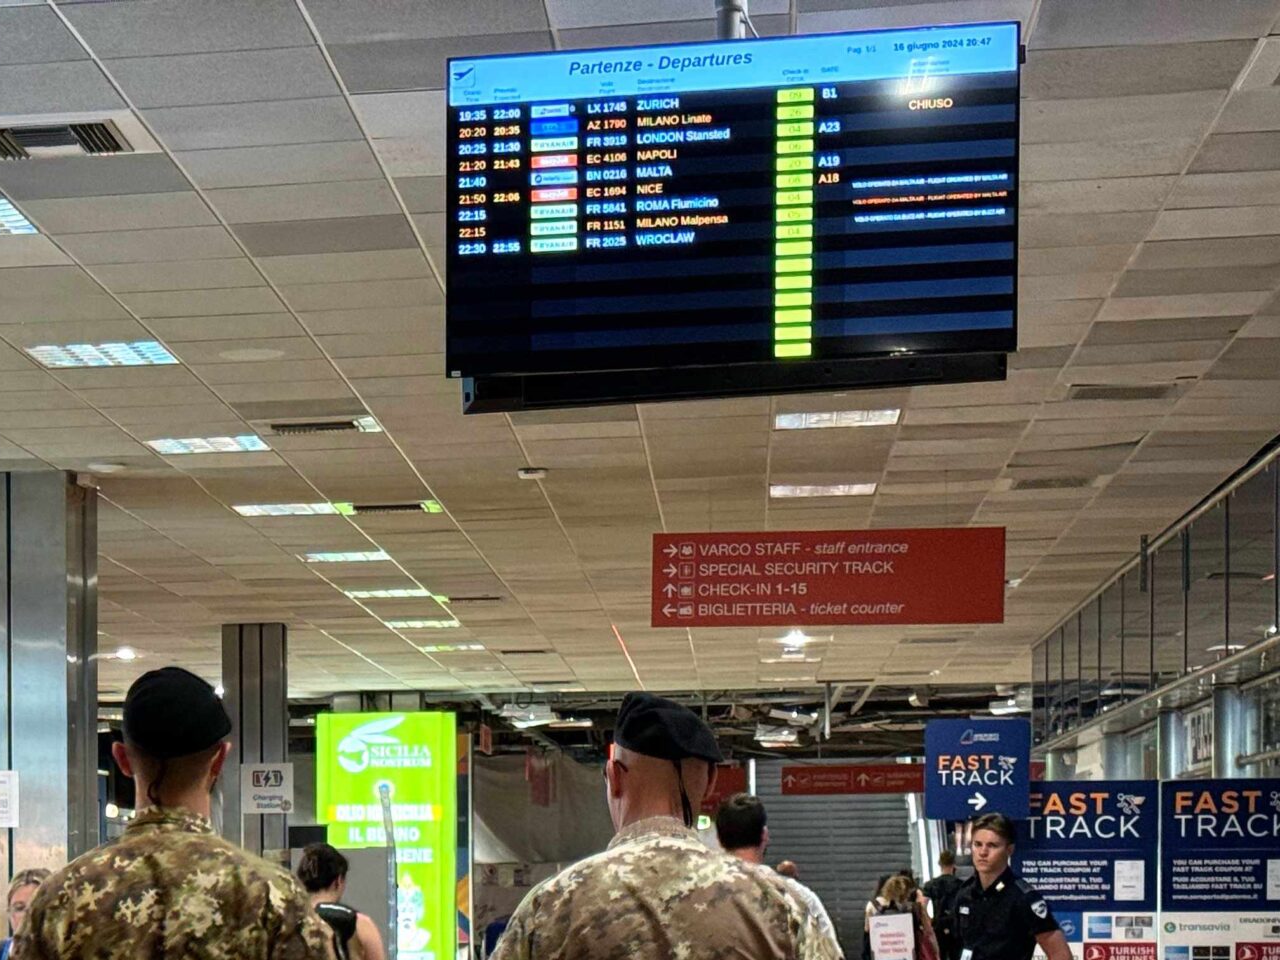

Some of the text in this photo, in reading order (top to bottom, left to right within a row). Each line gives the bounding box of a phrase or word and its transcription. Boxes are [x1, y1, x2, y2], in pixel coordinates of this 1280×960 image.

[894, 38, 991, 52] 16 giugno 2024 20:47
[569, 60, 643, 75] Partenze
[658, 52, 753, 72] Departures
[459, 110, 487, 121] 19:35
[493, 108, 521, 119] 22:00
[587, 103, 601, 113] LX
[603, 102, 627, 112] 1745
[636, 98, 679, 111] ZURICH
[822, 88, 837, 99] B1
[459, 127, 486, 138] 20:20
[493, 125, 520, 136] 20:35
[587, 121, 601, 131] AZ
[637, 116, 680, 127] MILANO
[682, 114, 712, 125] Linate
[908, 98, 953, 110] CHIUSO
[459, 143, 487, 155] 20:25
[493, 142, 521, 153] 21:30
[587, 137, 601, 147] FR
[637, 131, 684, 144] LONDON
[686, 128, 730, 141] Stansted
[818, 121, 840, 133] A23
[459, 161, 486, 171] 21:20
[493, 159, 520, 169] 21:43
[586, 155, 601, 164] EC
[603, 153, 627, 163] 4106
[637, 149, 677, 161] NAPOLI
[459, 177, 486, 188] 21:40
[586, 171, 601, 181] BN
[603, 169, 627, 179] 0216
[636, 166, 673, 178] MALTA
[818, 155, 840, 167] A19
[459, 194, 486, 204] 21:50
[493, 192, 520, 203] 22:06
[586, 188, 601, 197] EC
[637, 183, 663, 194] NICE
[818, 173, 840, 184] A18
[459, 210, 486, 221] 22:15
[586, 204, 601, 214] FR
[636, 200, 670, 211] ROMA
[671, 198, 719, 209] Fiumicino
[459, 227, 486, 238] 22:15
[586, 222, 601, 231] FR
[603, 221, 626, 230] 1151
[636, 217, 678, 228] MILANO
[681, 215, 728, 227] Malpensa
[459, 244, 486, 255] 22:30
[493, 242, 520, 253] 22:55
[586, 238, 601, 248] FR
[636, 232, 695, 245] WROCLAW
[699, 544, 751, 557] VARCO
[755, 543, 801, 556] STAFF
[814, 542, 845, 555] staff
[848, 542, 908, 555] entrance
[699, 561, 894, 577] SPECIAL SECURITY TRACK
[698, 582, 807, 596] CHECK-IN 1-15
[698, 603, 796, 616] BIGLIETTERIA
[810, 603, 847, 615] ticket
[850, 602, 904, 615] counter
[370, 744, 431, 757] SICILIA
[370, 758, 432, 768] NOSTRUM
[938, 755, 994, 770] FAST
[937, 770, 1014, 786] TRACK
[1175, 791, 1262, 814] FAST
[366, 827, 420, 843] BUNO
[1026, 815, 1140, 839] TRACK
[1179, 923, 1230, 931] transavia
[1109, 946, 1154, 955] TURKISH
